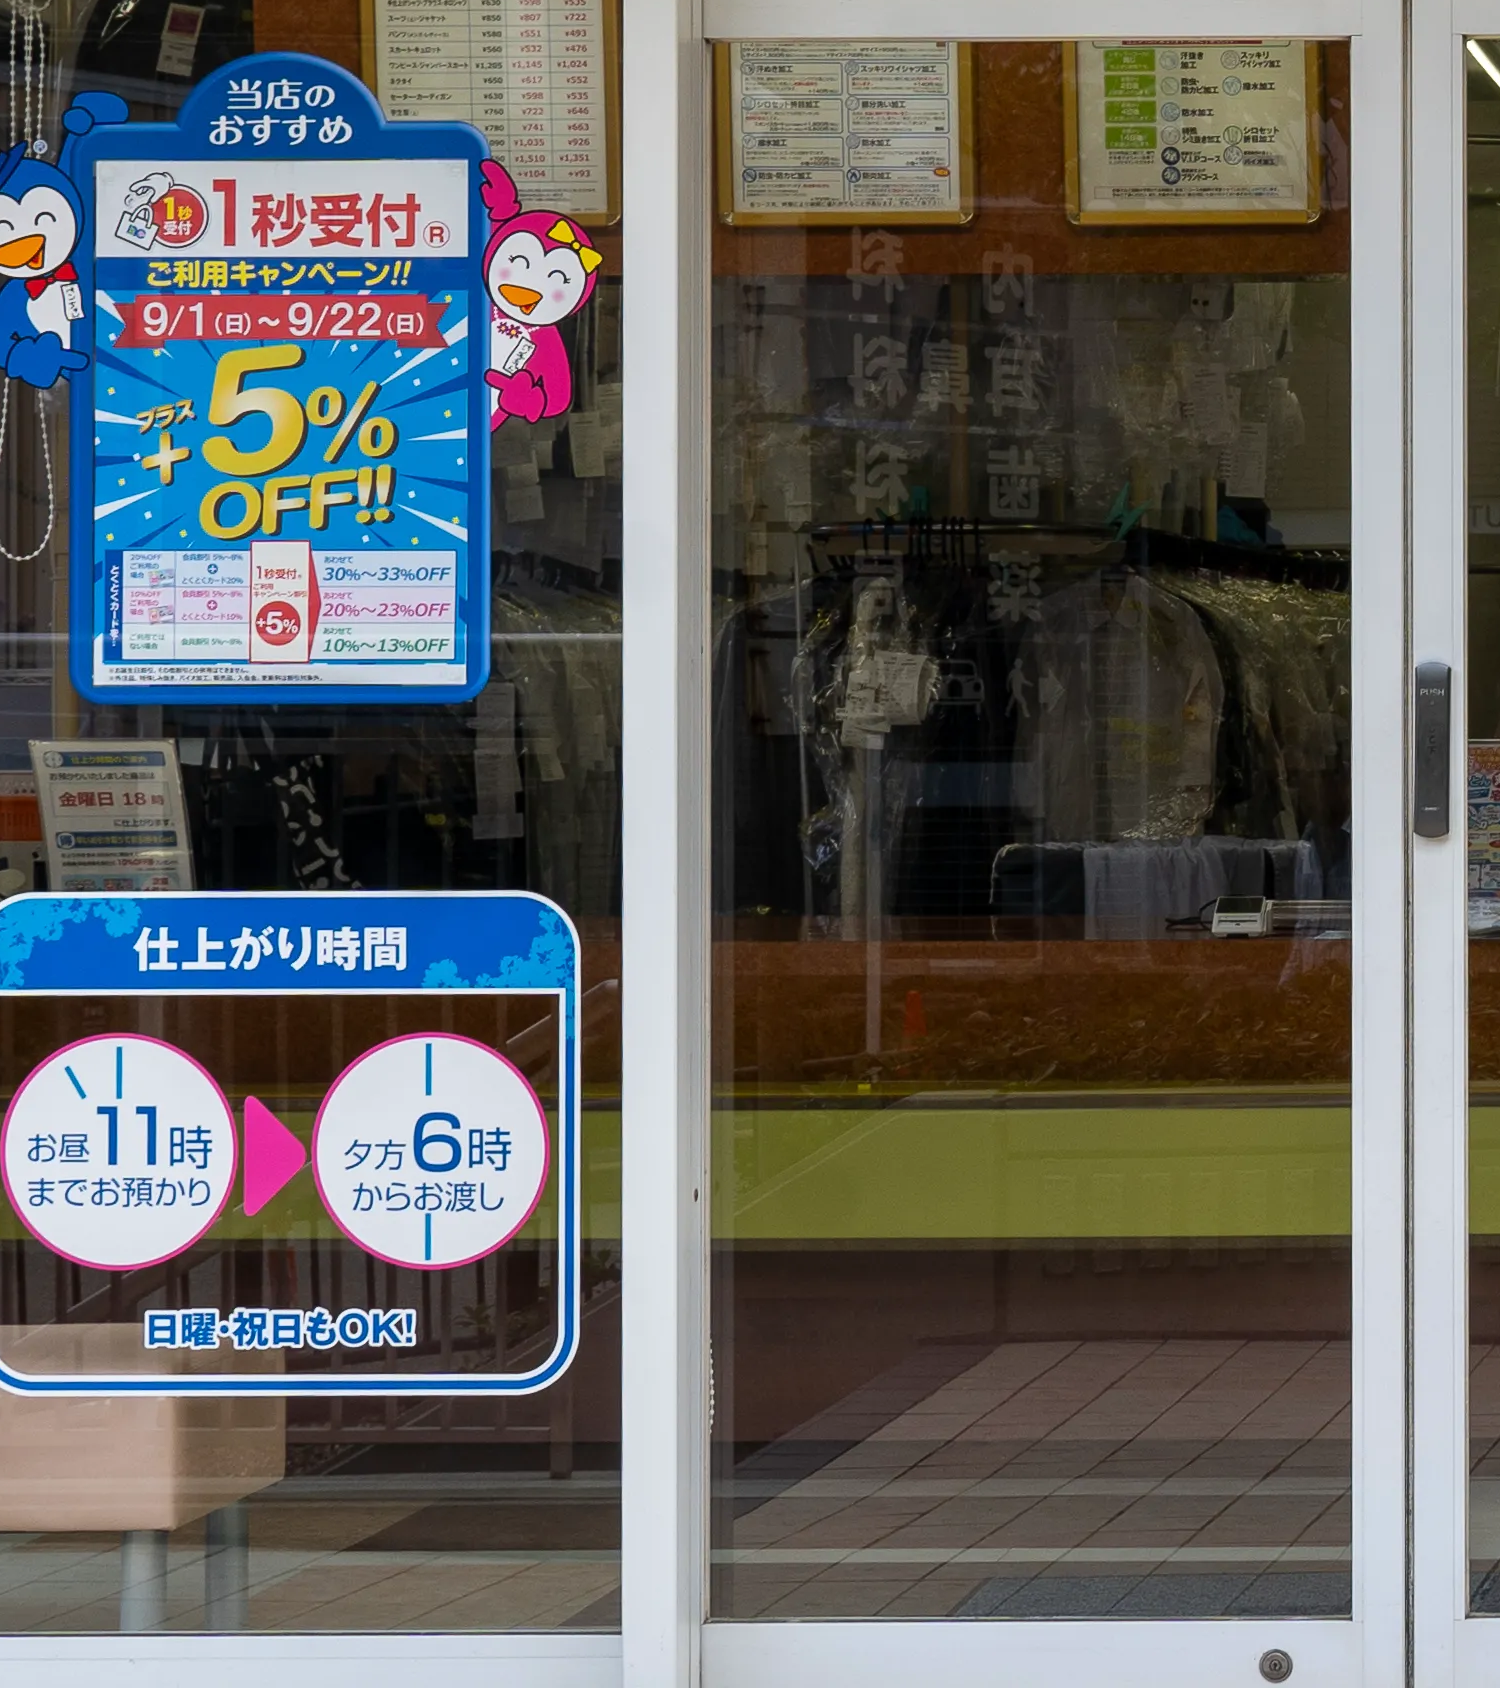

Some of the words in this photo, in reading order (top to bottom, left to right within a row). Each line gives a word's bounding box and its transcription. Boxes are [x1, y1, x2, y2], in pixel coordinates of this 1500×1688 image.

[1181, 61, 1196, 69] 加工
[226, 79, 336, 111] 当店の
[209, 114, 354, 146] おすすめ
[163, 220, 192, 236] 受付
[136, 399, 196, 433] プラス
[201, 344, 399, 476] 5%
[324, 556, 354, 564] あわせて
[1420, 688, 1445, 696] PUSH
[59, 791, 114, 807] 金曜日
[123, 792, 146, 806] 18
[134, 925, 408, 972] 仕上がり時間
[27, 1105, 213, 1170] お昼11時
[343, 1112, 512, 1173] 夕方6時
[27, 1177, 212, 1208] までお預かり
[352, 1182, 504, 1212] からお渡し
